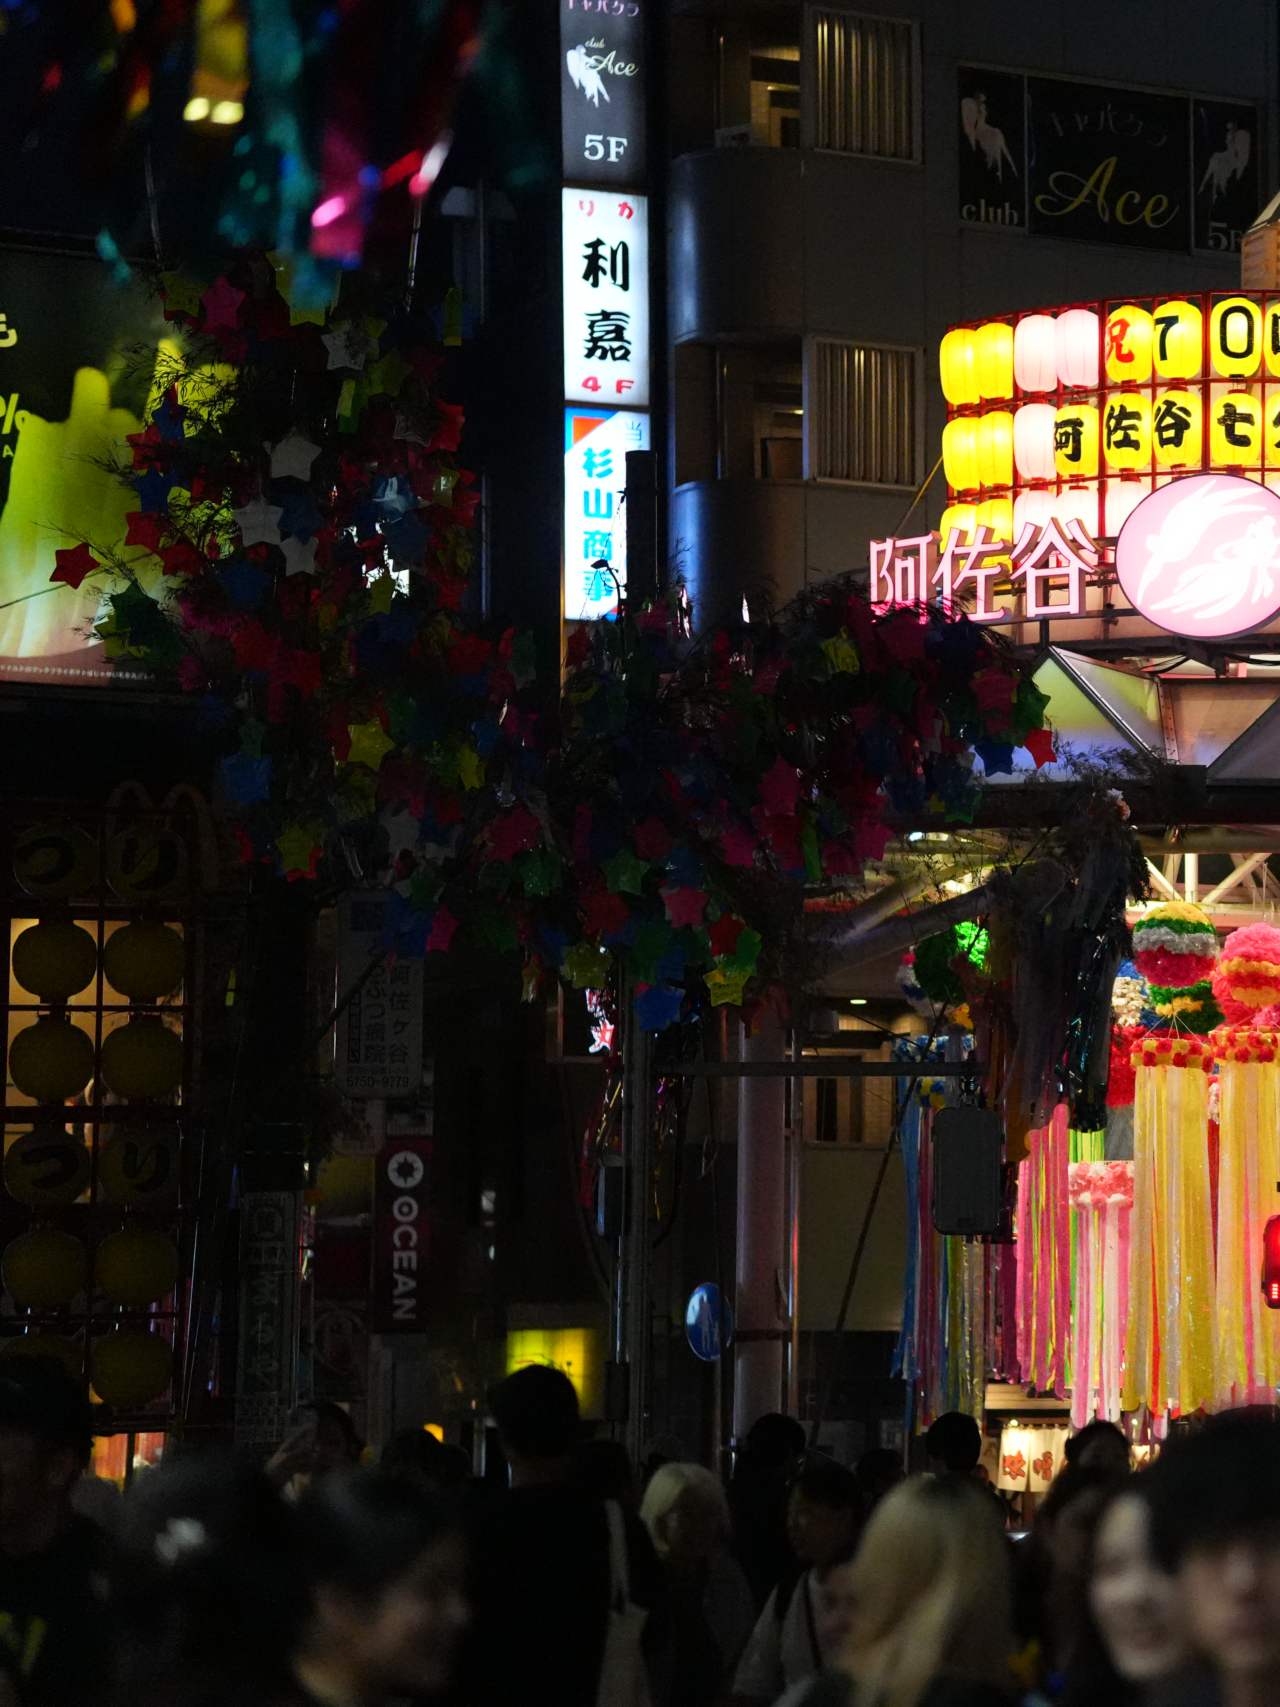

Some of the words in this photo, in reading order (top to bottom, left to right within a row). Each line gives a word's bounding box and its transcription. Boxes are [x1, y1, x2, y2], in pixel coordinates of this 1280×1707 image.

[586, 50, 639, 76] Ace
[583, 133, 628, 163] 5F
[961, 199, 1019, 226] club
[1034, 156, 1180, 229] Ace
[581, 237, 631, 362] 利嘉
[581, 376, 635, 395] 4F
[582, 447, 613, 601] 杉山商事
[869, 516, 1102, 625] 阿佐谷
[392, 1194, 420, 1322] OCEAN
